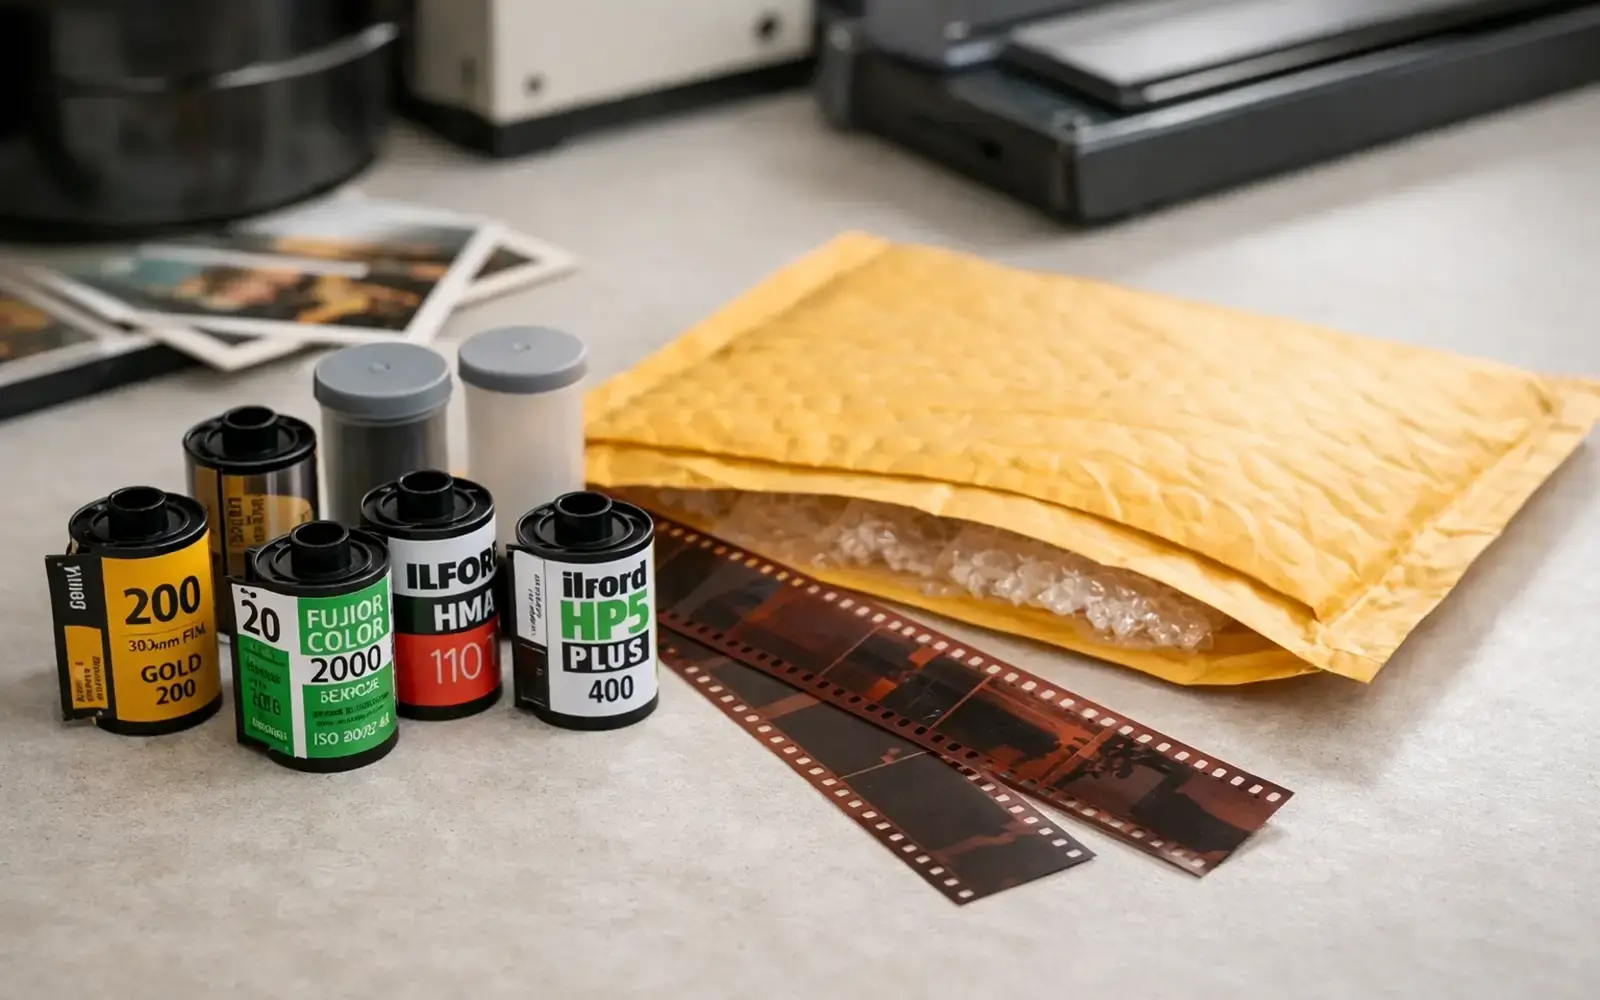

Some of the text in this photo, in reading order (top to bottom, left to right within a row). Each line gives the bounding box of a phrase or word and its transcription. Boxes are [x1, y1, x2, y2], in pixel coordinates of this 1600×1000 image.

[123, 575, 201, 625] 200
[307, 594, 384, 629] FUJIOR
[560, 588, 649, 641] HP5
[241, 599, 281, 643] 20
[307, 617, 384, 652] COLOR
[140, 653, 202, 683] GOLD
[310, 645, 382, 683] 2000
[570, 638, 643, 671] PLUS
[156, 678, 196, 705] 200
[588, 675, 634, 704] 400
